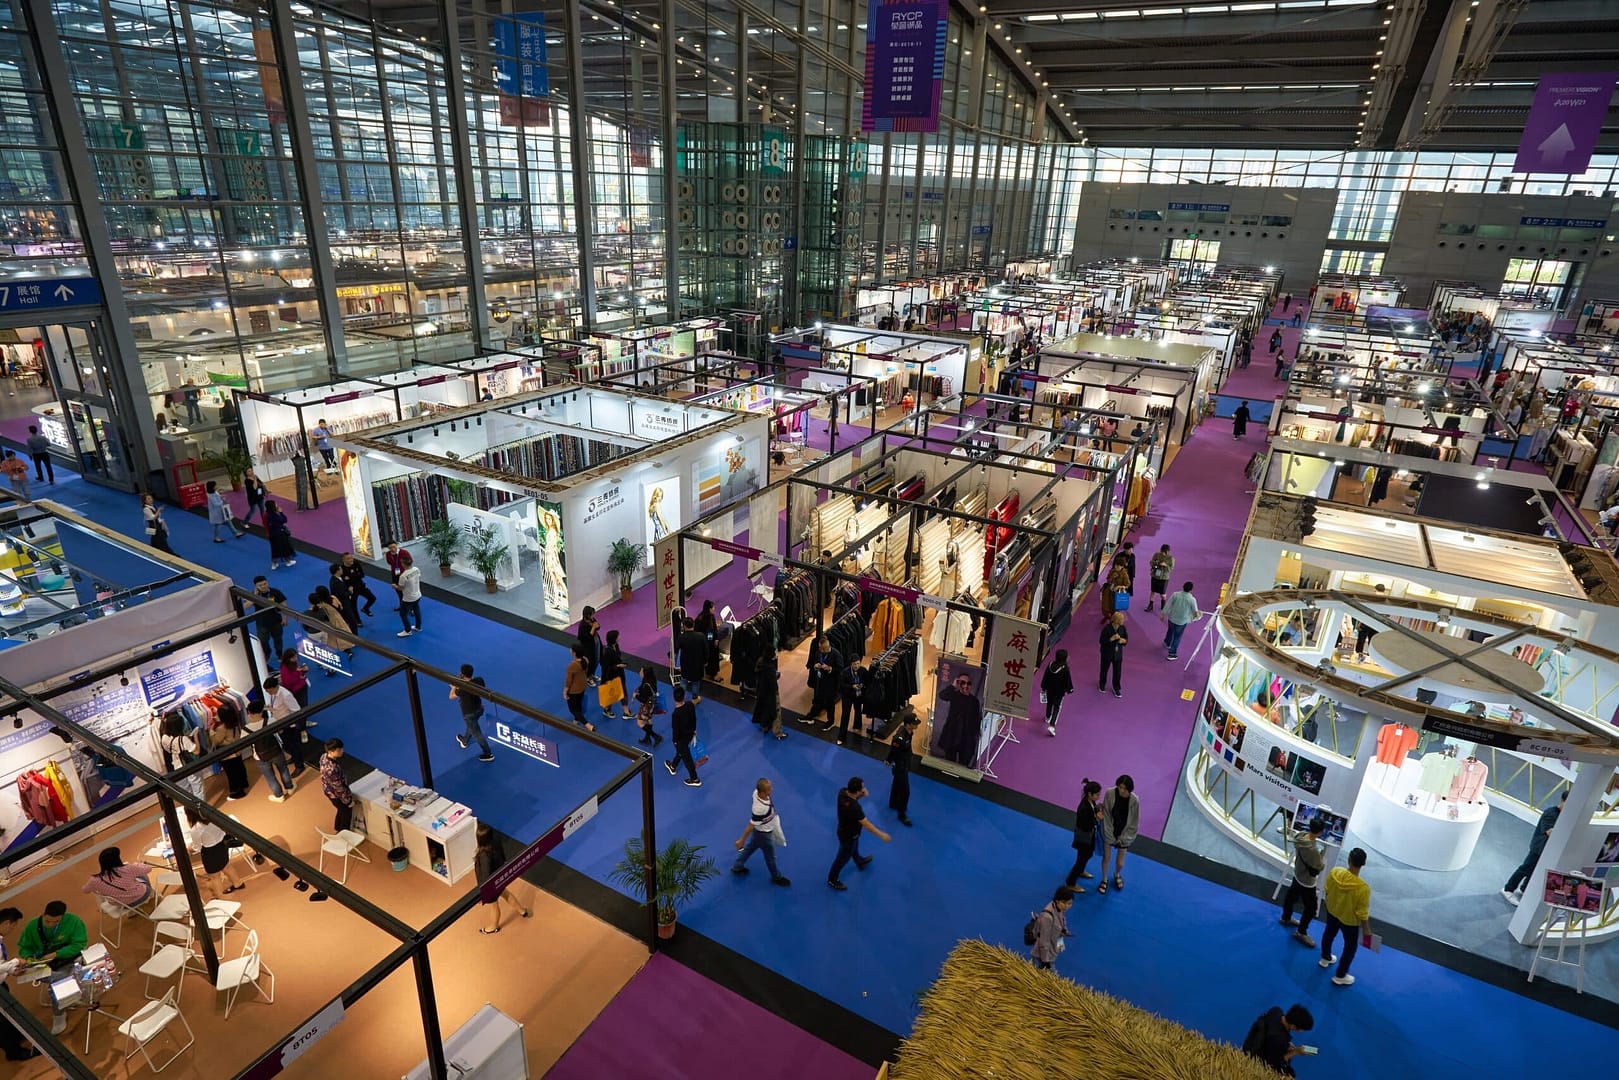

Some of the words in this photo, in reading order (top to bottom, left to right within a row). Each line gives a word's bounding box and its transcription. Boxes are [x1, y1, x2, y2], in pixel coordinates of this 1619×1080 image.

[892, 11, 923, 21] RYCP
[120, 129, 134, 146] 7
[242, 136, 254, 153] 7
[769, 138, 780, 166] 8
[855, 149, 863, 172] 8
[0, 286, 9, 306] 7
[17, 285, 40, 296] 展馆
[662, 548, 676, 610] 麻世界
[1001, 630, 1030, 702] 麻世界
[1246, 762, 1264, 777] Mars
[1264, 774, 1293, 793] visitors
